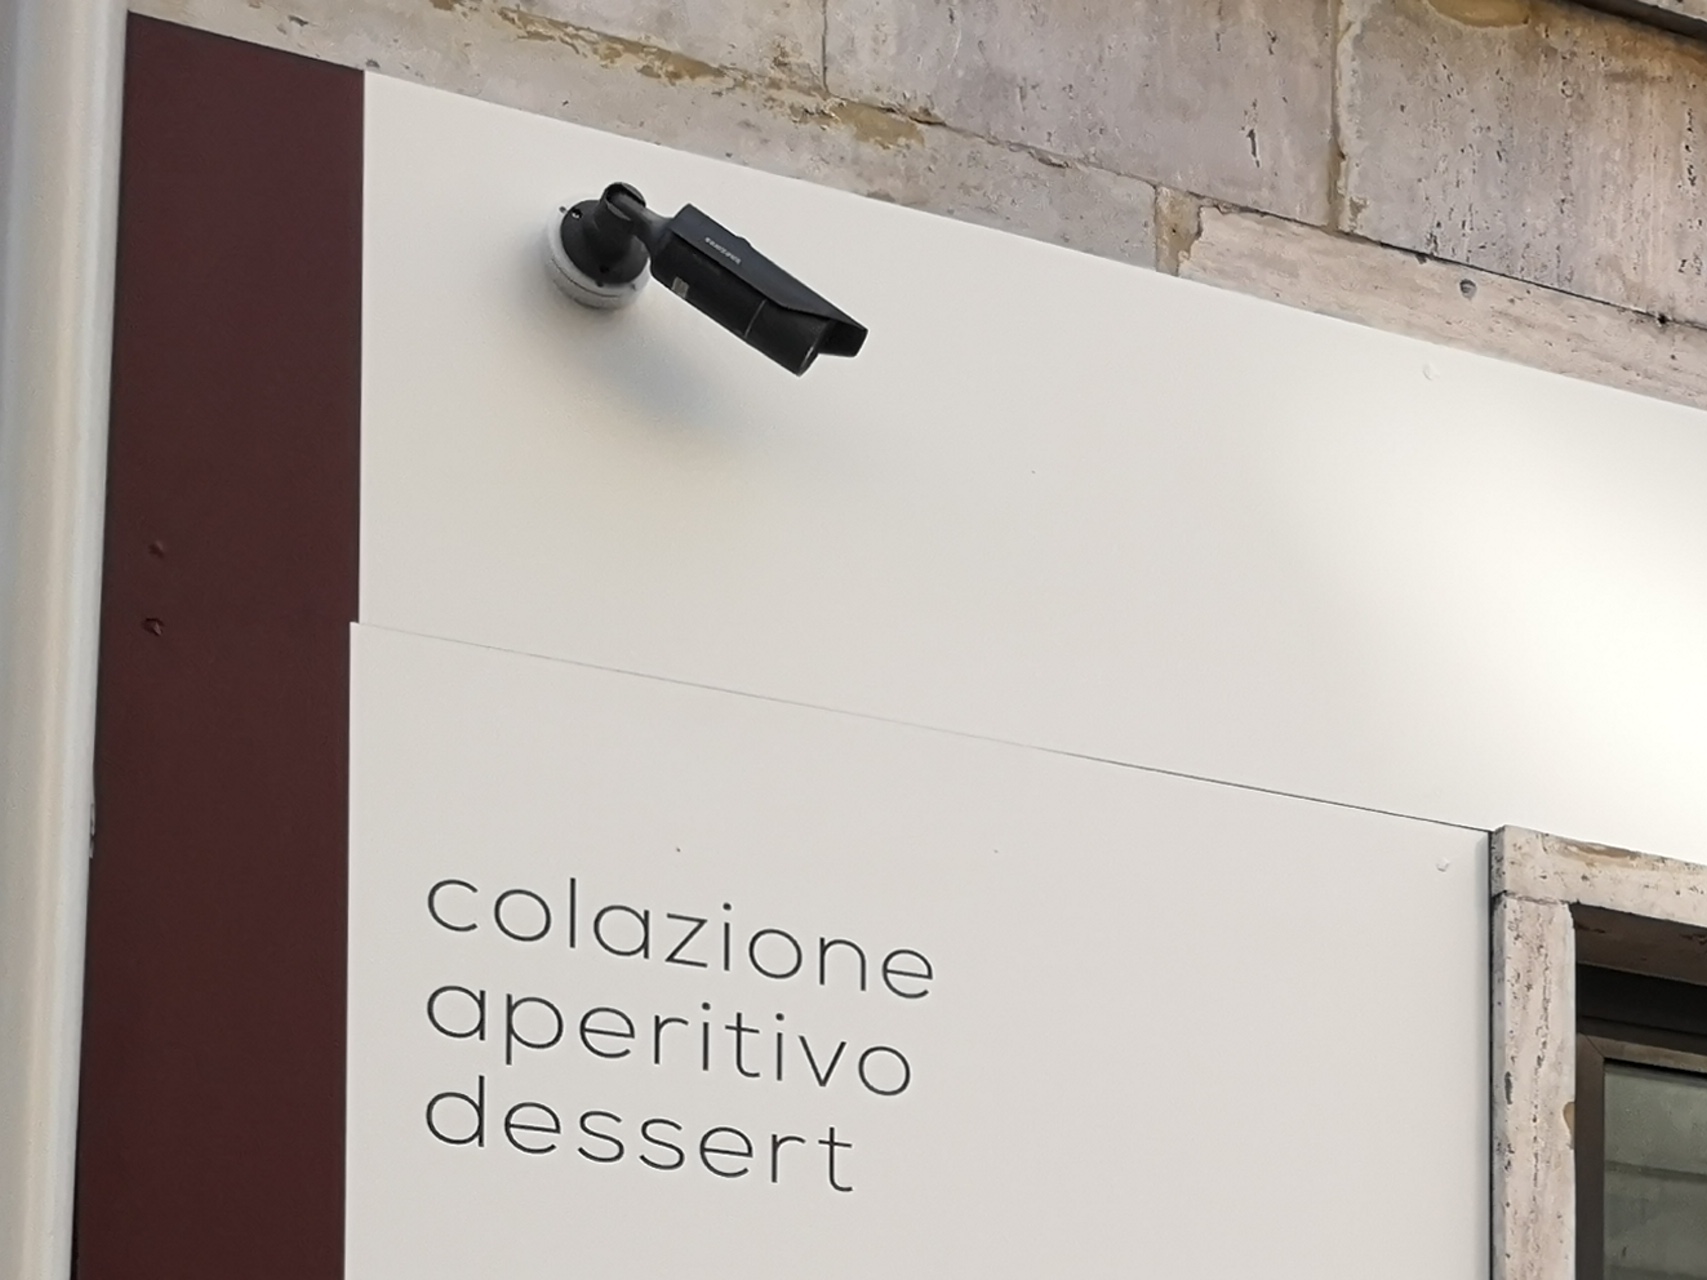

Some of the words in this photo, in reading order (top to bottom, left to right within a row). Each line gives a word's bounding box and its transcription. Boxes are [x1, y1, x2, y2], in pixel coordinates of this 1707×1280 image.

[427, 878, 934, 999] colazione
[427, 985, 911, 1096] aperitivo
[426, 1075, 853, 1192] dessert
